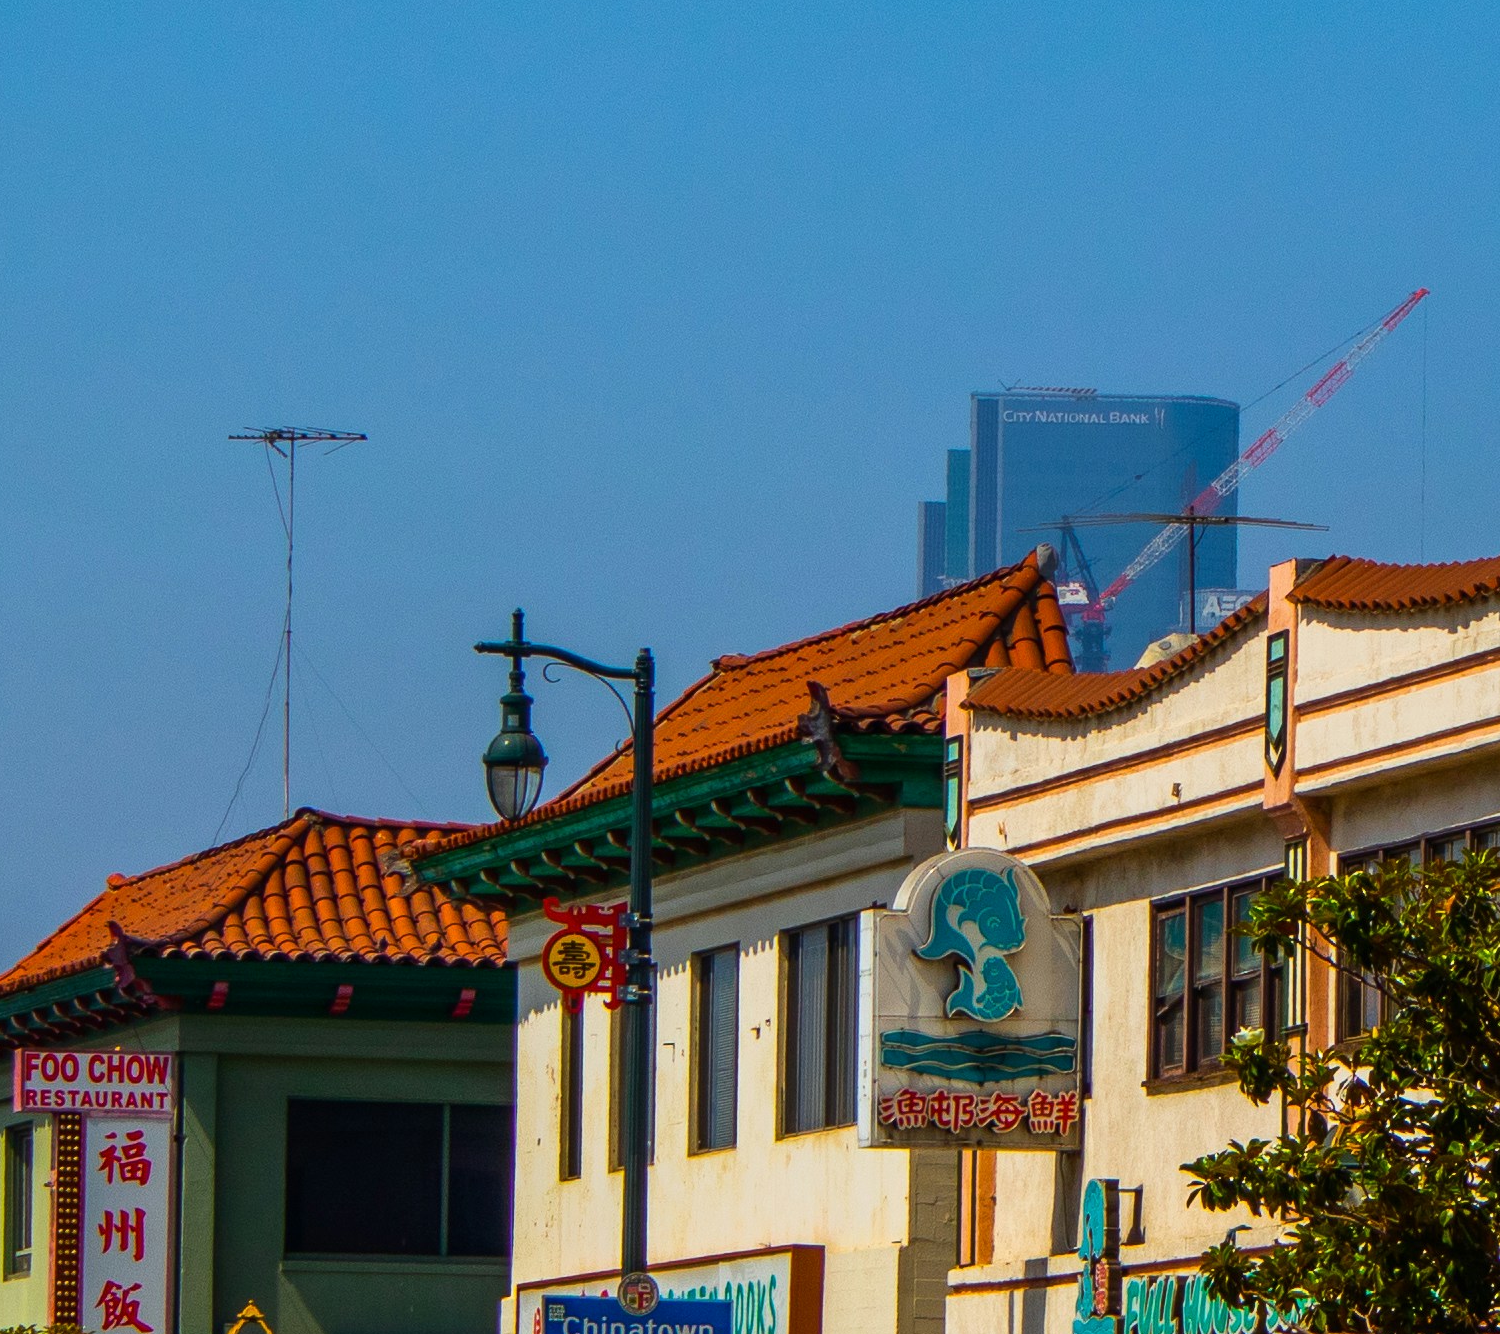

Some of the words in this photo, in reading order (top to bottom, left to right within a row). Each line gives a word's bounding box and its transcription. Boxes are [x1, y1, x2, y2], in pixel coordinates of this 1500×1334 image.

[1002, 410, 1033, 423] CITY
[1034, 411, 1107, 424] NATIONAL
[1109, 411, 1150, 425] BANK
[25, 1053, 80, 1083] FOO
[87, 1053, 170, 1085] CHOW
[25, 1089, 170, 1110] RESTAURANT
